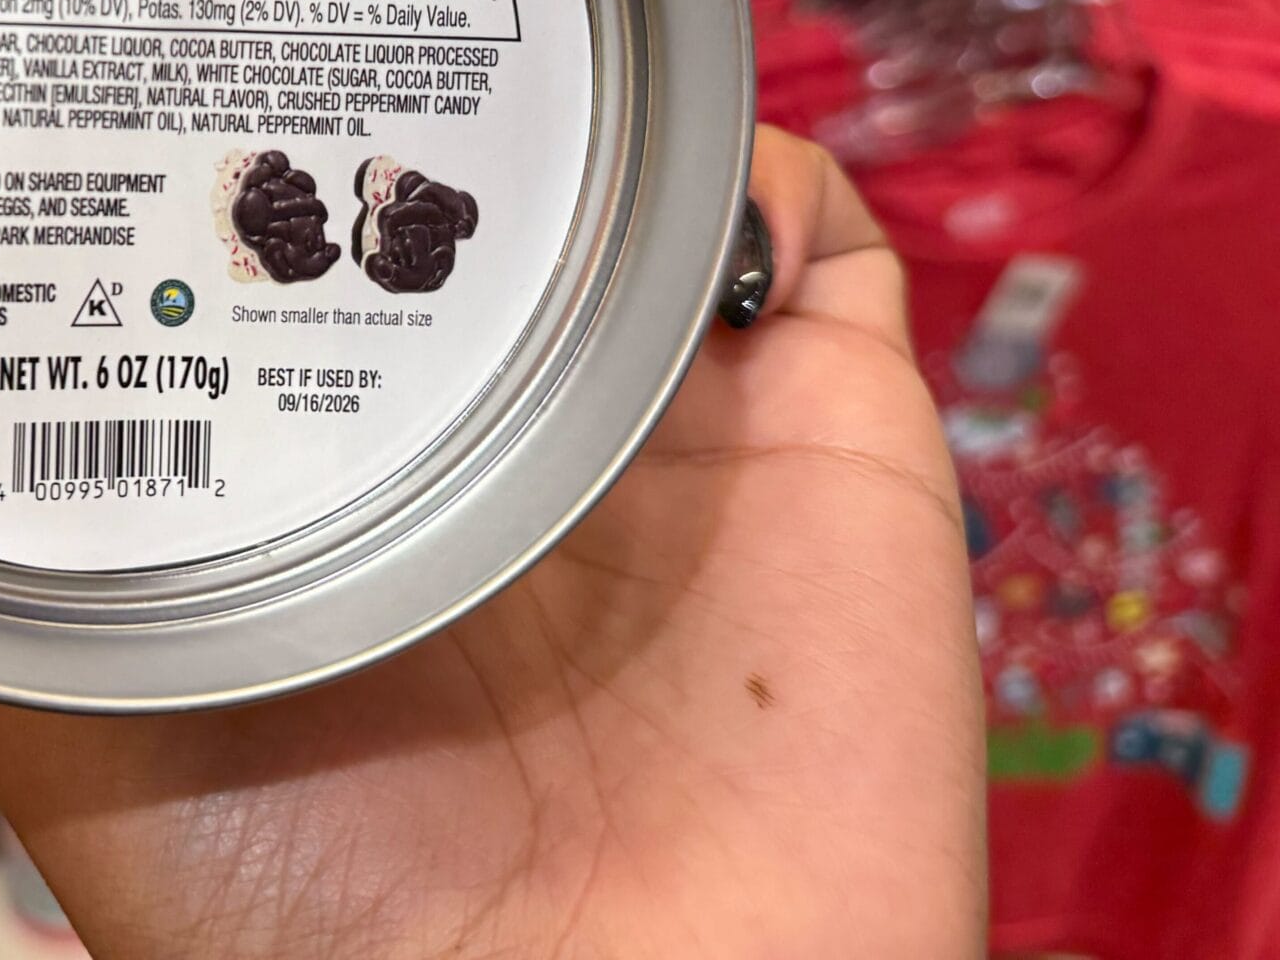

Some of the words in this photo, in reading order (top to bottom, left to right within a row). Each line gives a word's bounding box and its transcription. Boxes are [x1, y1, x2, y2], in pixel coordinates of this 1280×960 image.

[241, 0, 269, 27] (2%
[274, 0, 304, 28] DV).
[328, 1, 350, 24] DV
[387, 3, 422, 32] Daily
[427, 4, 470, 28] Value.
[170, 38, 216, 59] COCOA
[220, 39, 276, 63] BUTTER,
[281, 41, 361, 63] CHOCOLATE
[365, 43, 414, 65] LIQUOR
[418, 45, 498, 67] PROCESSED
[151, 62, 191, 86] MILK),
[197, 63, 239, 84] WHITE
[243, 65, 324, 87] CHOCOLATE
[328, 67, 380, 92] (SUGAR,
[386, 69, 432, 90] COCOA
[437, 70, 492, 95] BUTTER,
[147, 86, 209, 108] NATURAL
[213, 88, 272, 113] FLAVOR),
[278, 89, 341, 112] CRUSHED
[345, 92, 430, 115] PEPPERMINT
[434, 94, 480, 116] CANDY
[68, 108, 154, 131] PEPPERMINT
[157, 111, 186, 135] OIL),
[192, 112, 254, 134] NATURAL
[258, 112, 343, 136] PEPPERMINT
[347, 116, 371, 137] OIL.
[28, 171, 83, 193] SHARED
[86, 172, 166, 194] EQUIPMENT
[33, 225, 135, 247] MERCHANDISE
[111, 282, 124, 296] D
[89, 299, 107, 316] K
[232, 305, 276, 323] Shown
[281, 307, 329, 324] smaller
[333, 308, 360, 325] than
[365, 309, 403, 326] actual
[407, 310, 432, 327] size
[0, 356, 40, 392] NET
[48, 355, 88, 391] WT.
[96, 355, 109, 389] 6
[117, 355, 148, 389] OZ
[156, 355, 229, 399] (170g)
[258, 367, 295, 387] BEST
[299, 368, 312, 387] IF
[317, 368, 354, 388] USED
[359, 369, 381, 389] BY:
[278, 393, 359, 413] 09/16/2026
[35, 480, 103, 501] 00995
[117, 479, 184, 498] 01871
[215, 479, 225, 497] 2
